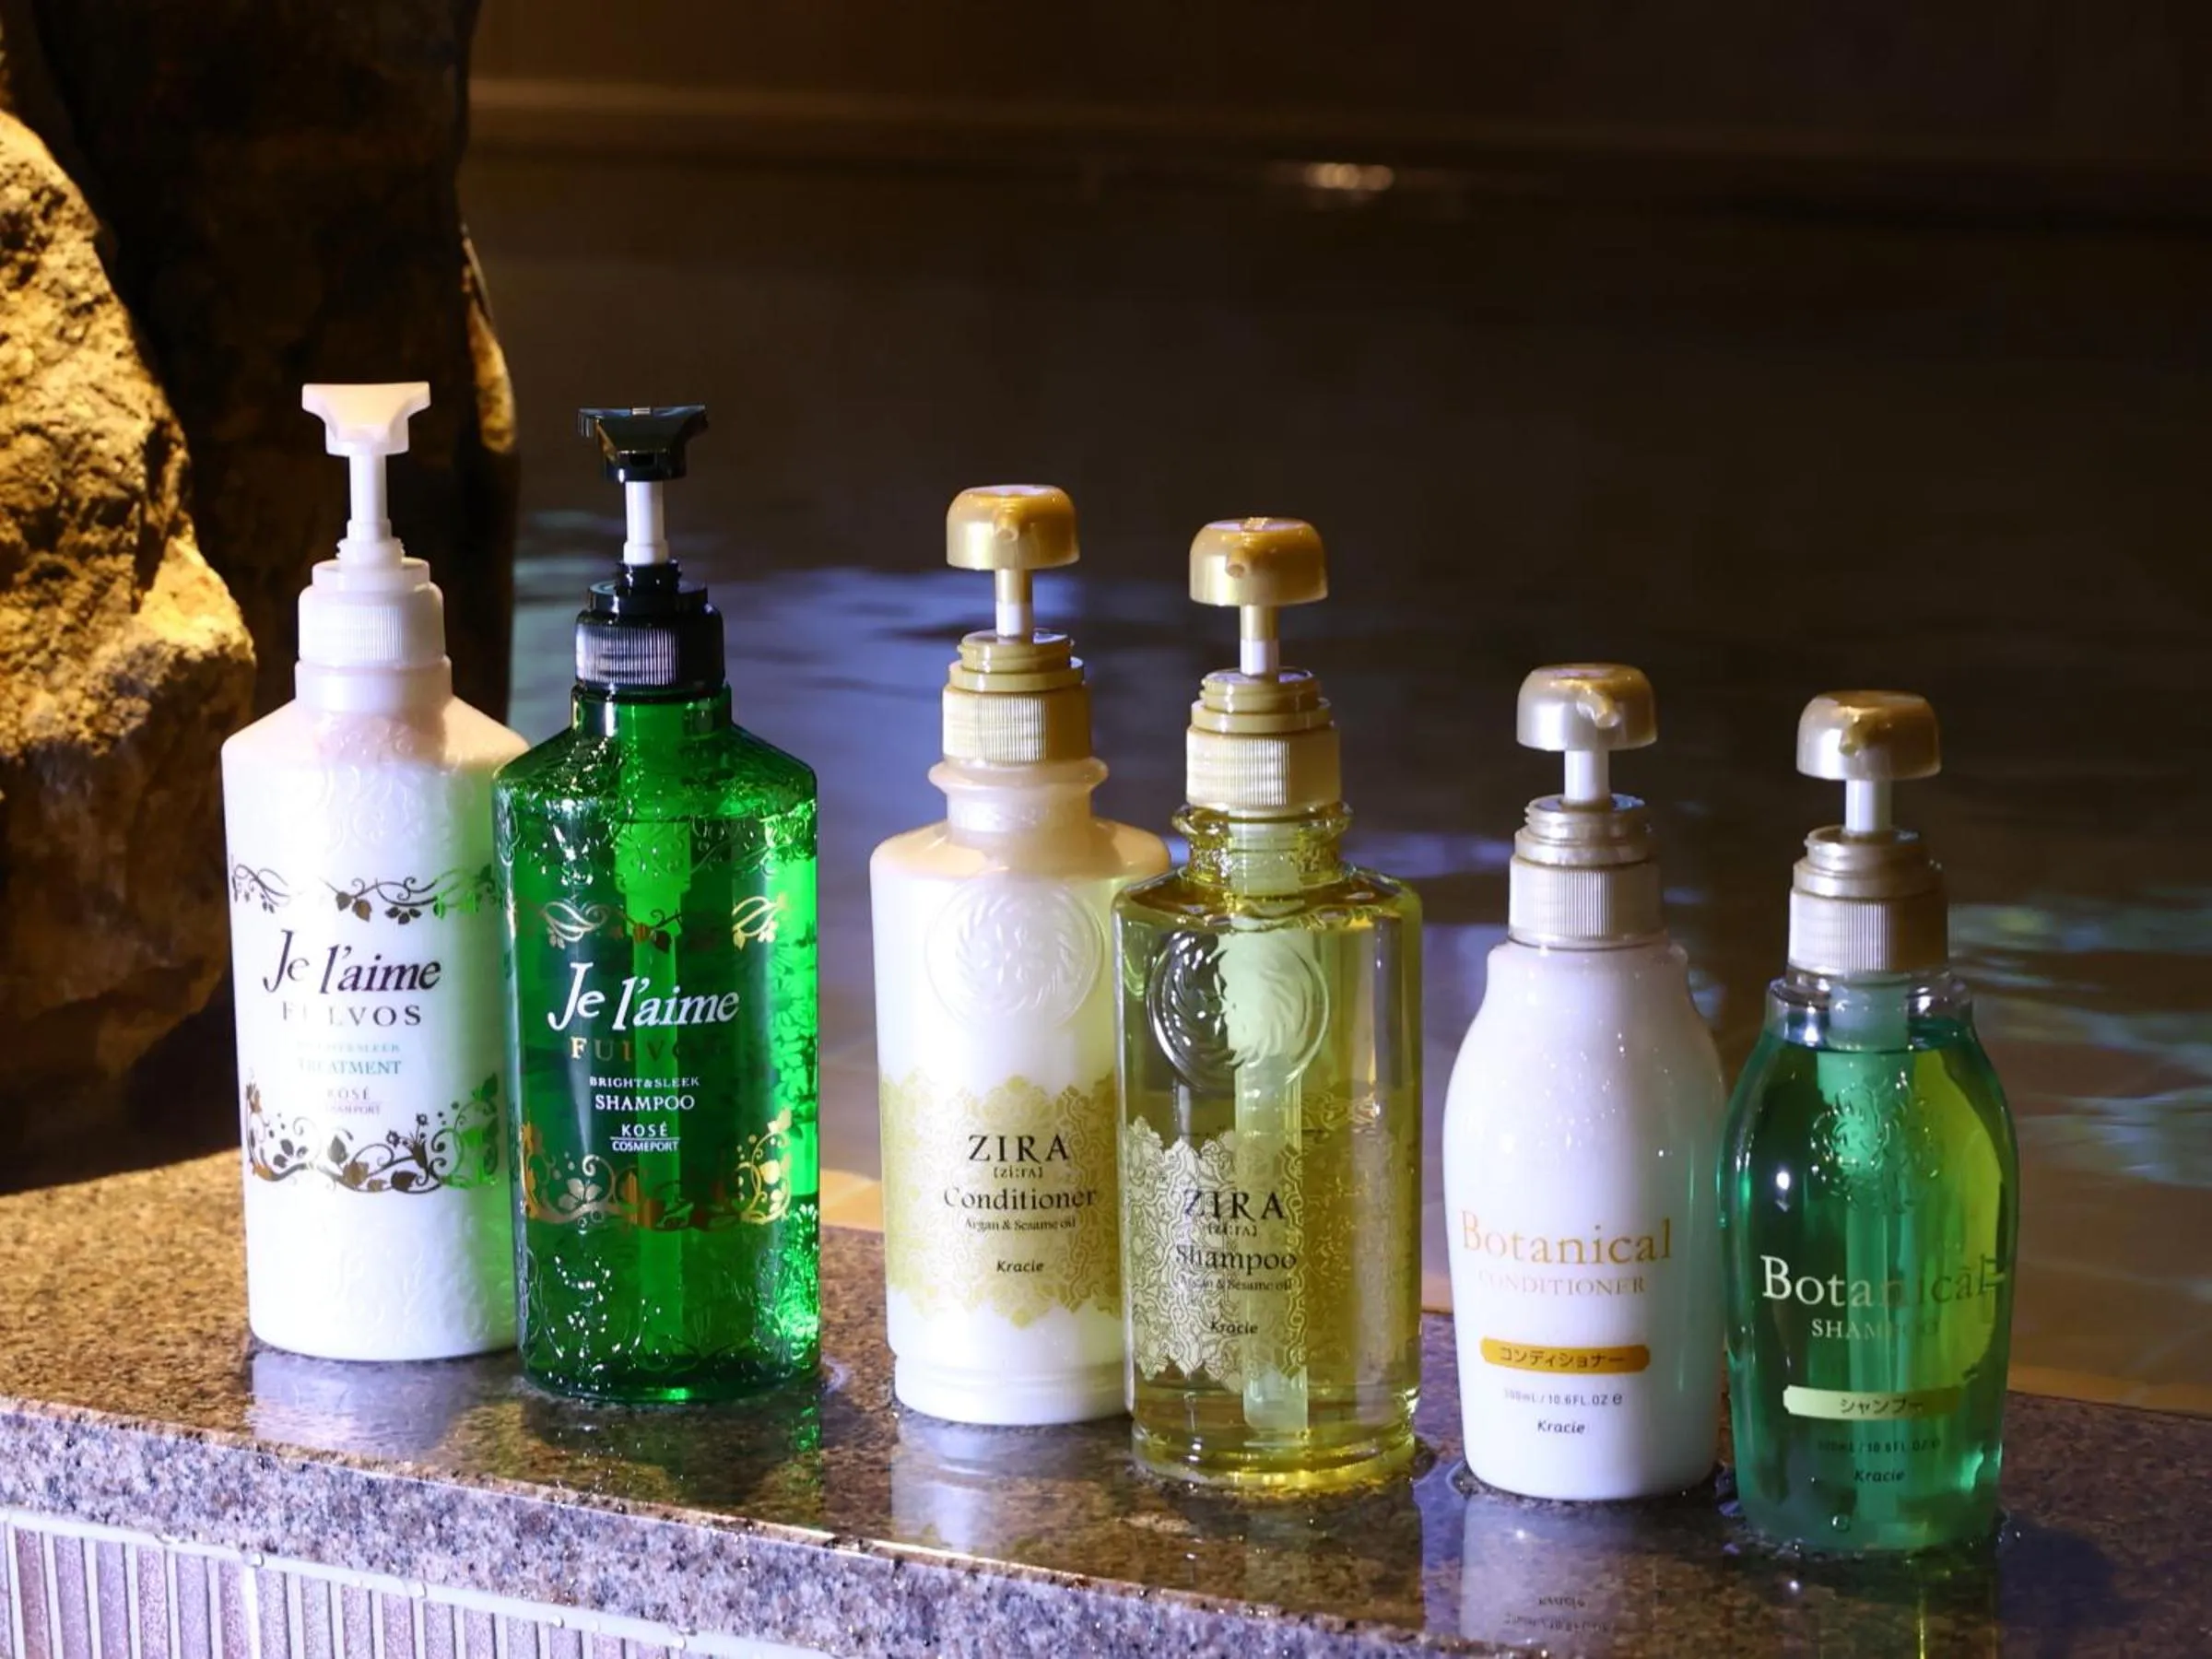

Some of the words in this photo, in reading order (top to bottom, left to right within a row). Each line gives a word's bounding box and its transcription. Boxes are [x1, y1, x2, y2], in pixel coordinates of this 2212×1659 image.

[262, 929, 311, 993] Je
[319, 944, 442, 994] l'aime
[547, 961, 606, 1030] Je
[612, 975, 739, 1030] l'aime
[281, 1000, 422, 1028] FLVOS
[589, 1076, 700, 1088] BRIGHT&SLEEK
[594, 1094, 695, 1112] SHAMPOO
[621, 1121, 668, 1138] KOSÉ
[612, 1138, 679, 1153] COSMEPORT
[968, 1134, 1070, 1163] ZIRA
[944, 1186, 1097, 1210] Conditioner
[1183, 1190, 1287, 1223] ZIRA
[1002, 1219, 1011, 1231] &
[1060, 1217, 1077, 1229] oil
[1462, 1210, 1672, 1265] Botanical
[996, 1260, 1044, 1273] Kracie
[1175, 1244, 1297, 1276] Shampoo
[1210, 1320, 1259, 1335] Kracie
[1499, 1347, 1625, 1370] コンディショナー
[1536, 1419, 1586, 1434] Kracie
[1853, 1469, 1906, 1483] Kracie
